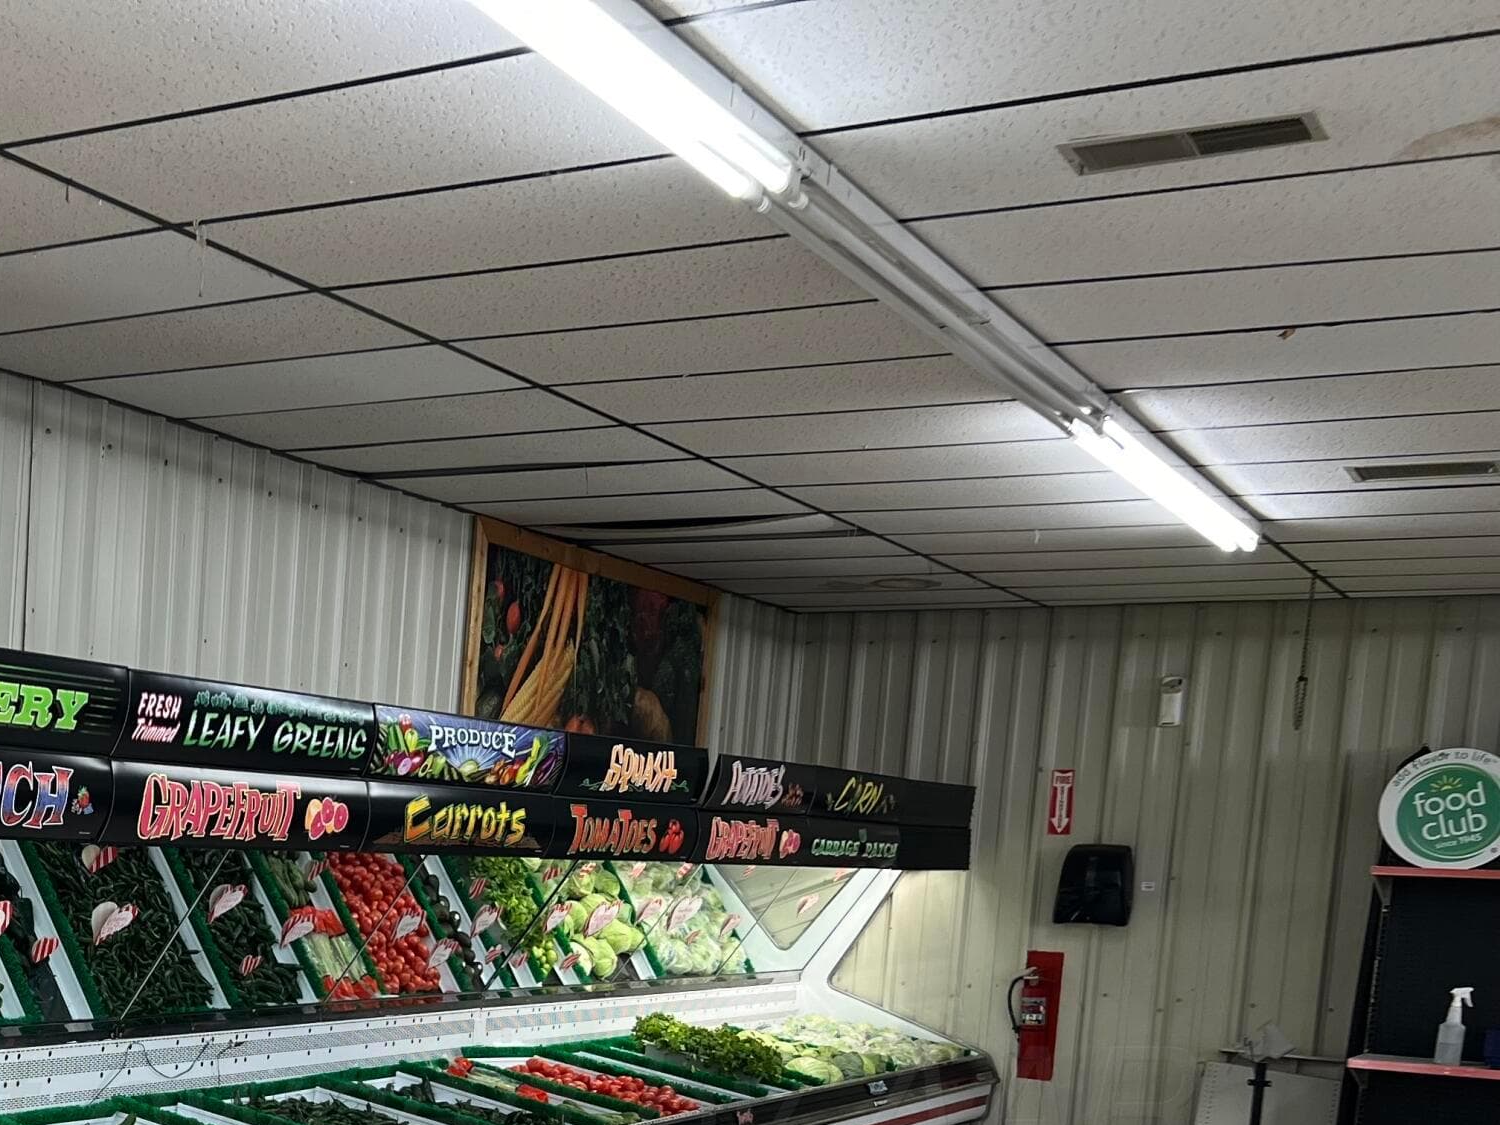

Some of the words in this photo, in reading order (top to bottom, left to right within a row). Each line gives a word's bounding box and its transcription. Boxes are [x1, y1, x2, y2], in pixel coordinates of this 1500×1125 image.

[137, 692, 182, 719] FRESH
[131, 718, 181, 744] Trimmed
[183, 709, 267, 751] LEAFY
[273, 720, 367, 760] GREENS
[428, 725, 517, 759] PRODUCE
[137, 772, 302, 842] GRAPEFRUIT
[1412, 781, 1486, 817] food
[403, 793, 527, 847] Carrots
[1422, 808, 1487, 840] club
